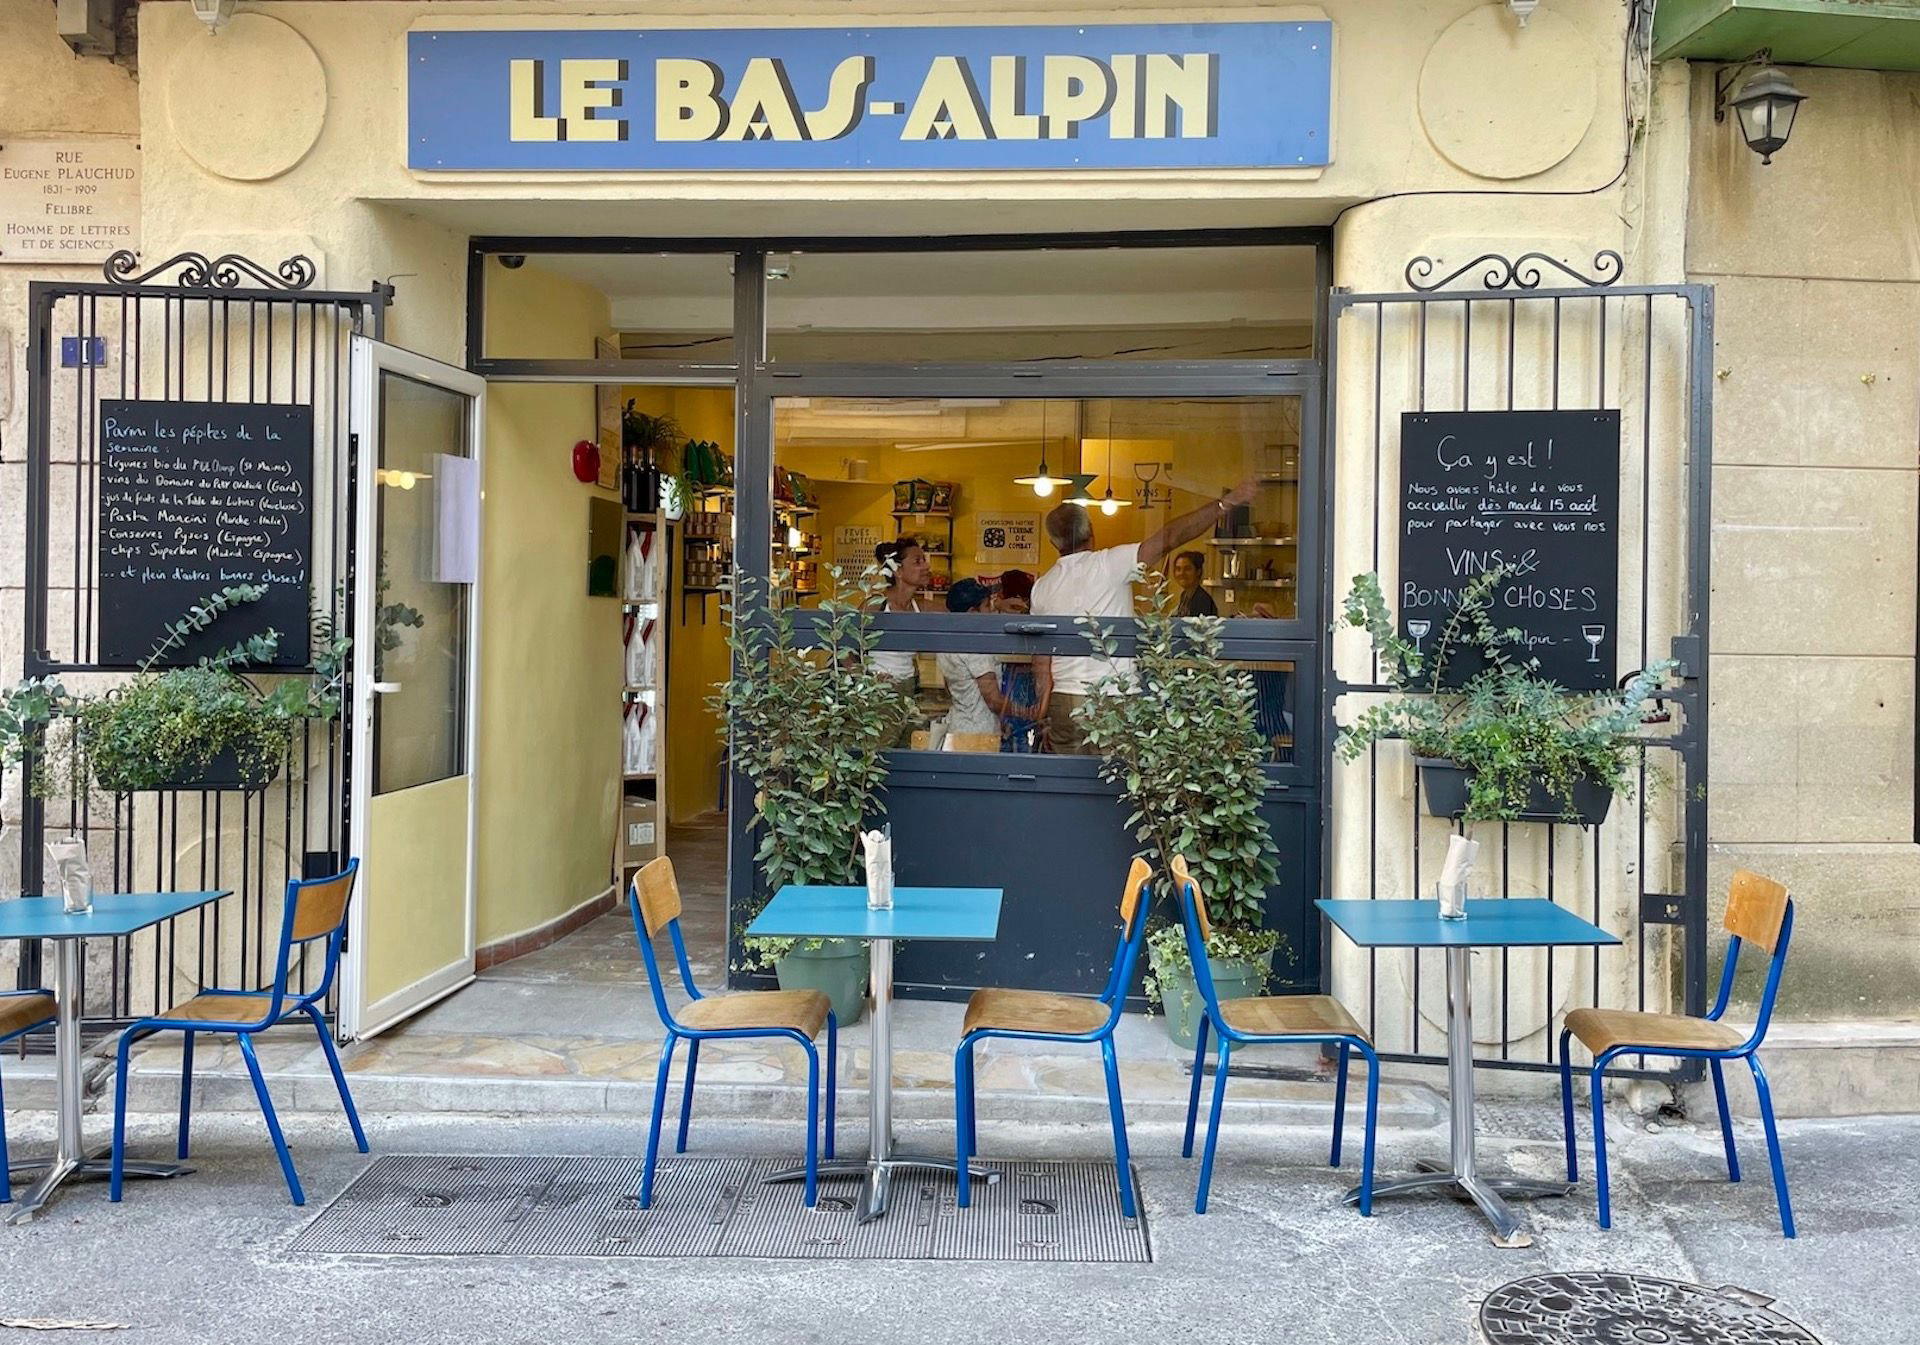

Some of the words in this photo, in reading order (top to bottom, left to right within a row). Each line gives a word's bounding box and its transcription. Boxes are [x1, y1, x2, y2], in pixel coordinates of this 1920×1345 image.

[510, 59, 628, 141] LE
[656, 53, 1219, 141] BAS-ALPIN
[56, 152, 84, 163] RUE
[58, 168, 135, 179] PLAUCHUD
[43, 185, 62, 194] 1831
[75, 185, 97, 194] 1909
[7, 224, 53, 235] HOMME
[60, 226, 75, 235] DE
[81, 226, 130, 235] LETTRES
[22, 240, 35, 249] ET
[40, 240, 54, 249] DE
[60, 240, 114, 249] SCIENCES
[105, 417, 147, 438] Parmi
[155, 419, 176, 438] les
[182, 422, 228, 445] pépites
[236, 424, 254, 440] de
[265, 425, 282, 440] la
[154, 458, 170, 469] bio
[173, 457, 187, 470] du
[1437, 435, 1473, 471] Ça
[1483, 455, 1498, 479] y
[1507, 441, 1537, 469] est
[107, 476, 130, 485] vins
[136, 473, 149, 484] du
[156, 474, 194, 487] Domaine
[199, 479, 211, 488] du
[267, 478, 303, 497] (Gard)
[1408, 483, 1438, 496] Nous
[1446, 486, 1479, 495] avons
[1488, 481, 1518, 494] hâte
[1530, 482, 1547, 493] de
[1557, 483, 1584, 493] vous
[105, 493, 120, 507] jus
[122, 492, 132, 503] de
[160, 493, 170, 504] de
[173, 493, 184, 505] la
[1406, 498, 1467, 512] accueillir
[1477, 499, 1501, 511] dès
[1507, 499, 1543, 511] mardi
[1549, 498, 1564, 511] 15
[109, 507, 149, 523] Pasta
[157, 509, 207, 524] Mancini
[1407, 519, 1436, 535] pour
[1445, 516, 1504, 535] partager
[1513, 521, 1546, 532] avec
[1552, 522, 1577, 532] vous
[1583, 522, 1607, 532] nos
[109, 528, 163, 539] Conserves
[217, 529, 271, 548] (Espagne)
[111, 543, 141, 559] chips
[252, 548, 302, 566] Espagne)
[1446, 547, 1503, 577] VINS
[120, 565, 137, 578] et
[142, 566, 167, 584] plein
[172, 567, 210, 581] d'autres
[220, 568, 254, 581] bonnes
[1503, 584, 1598, 612] CHOSES
